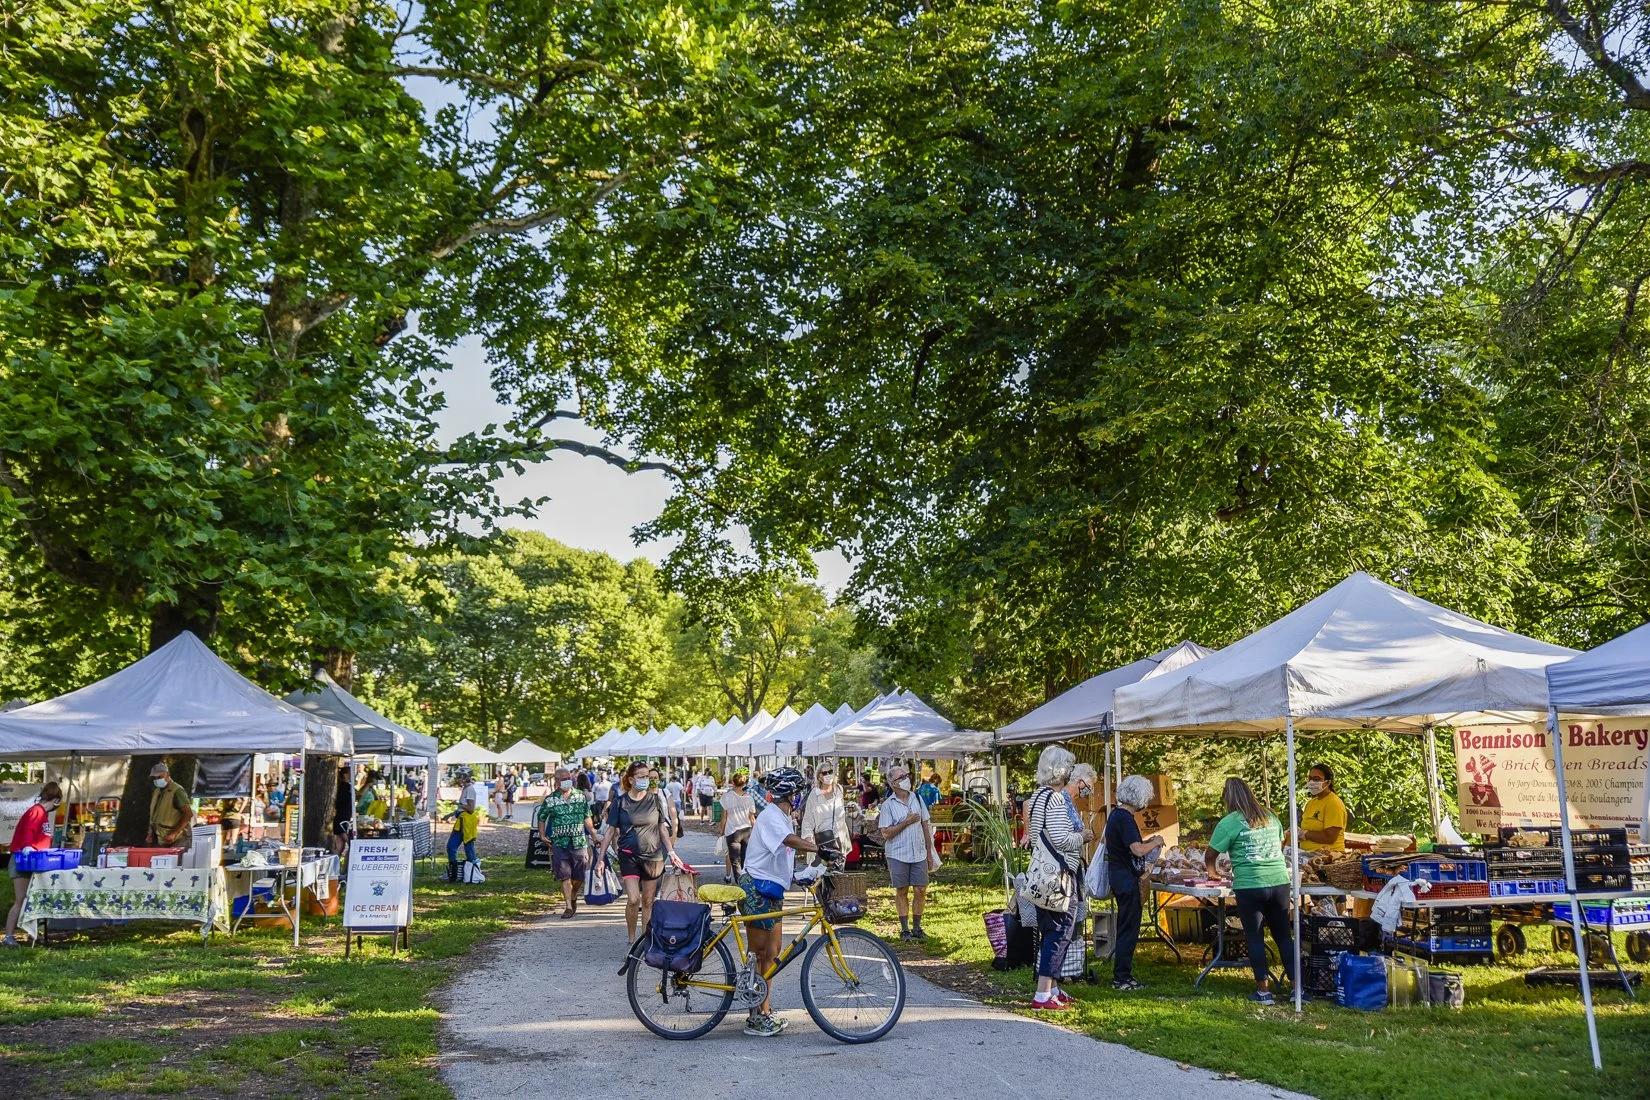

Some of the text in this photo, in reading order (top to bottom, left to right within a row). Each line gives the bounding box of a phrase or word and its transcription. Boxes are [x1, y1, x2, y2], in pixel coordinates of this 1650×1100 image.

[1459, 723, 1648, 750] Bennison Bakery
[1502, 756, 1648, 773] Brick Oen Breads
[1586, 779, 1602, 788] 2005
[1605, 778, 1644, 792] Champion
[1571, 791, 1579, 802] de
[1580, 791, 1587, 803] la
[1588, 793, 1633, 807] Boulangerie
[1476, 820, 1487, 828] We
